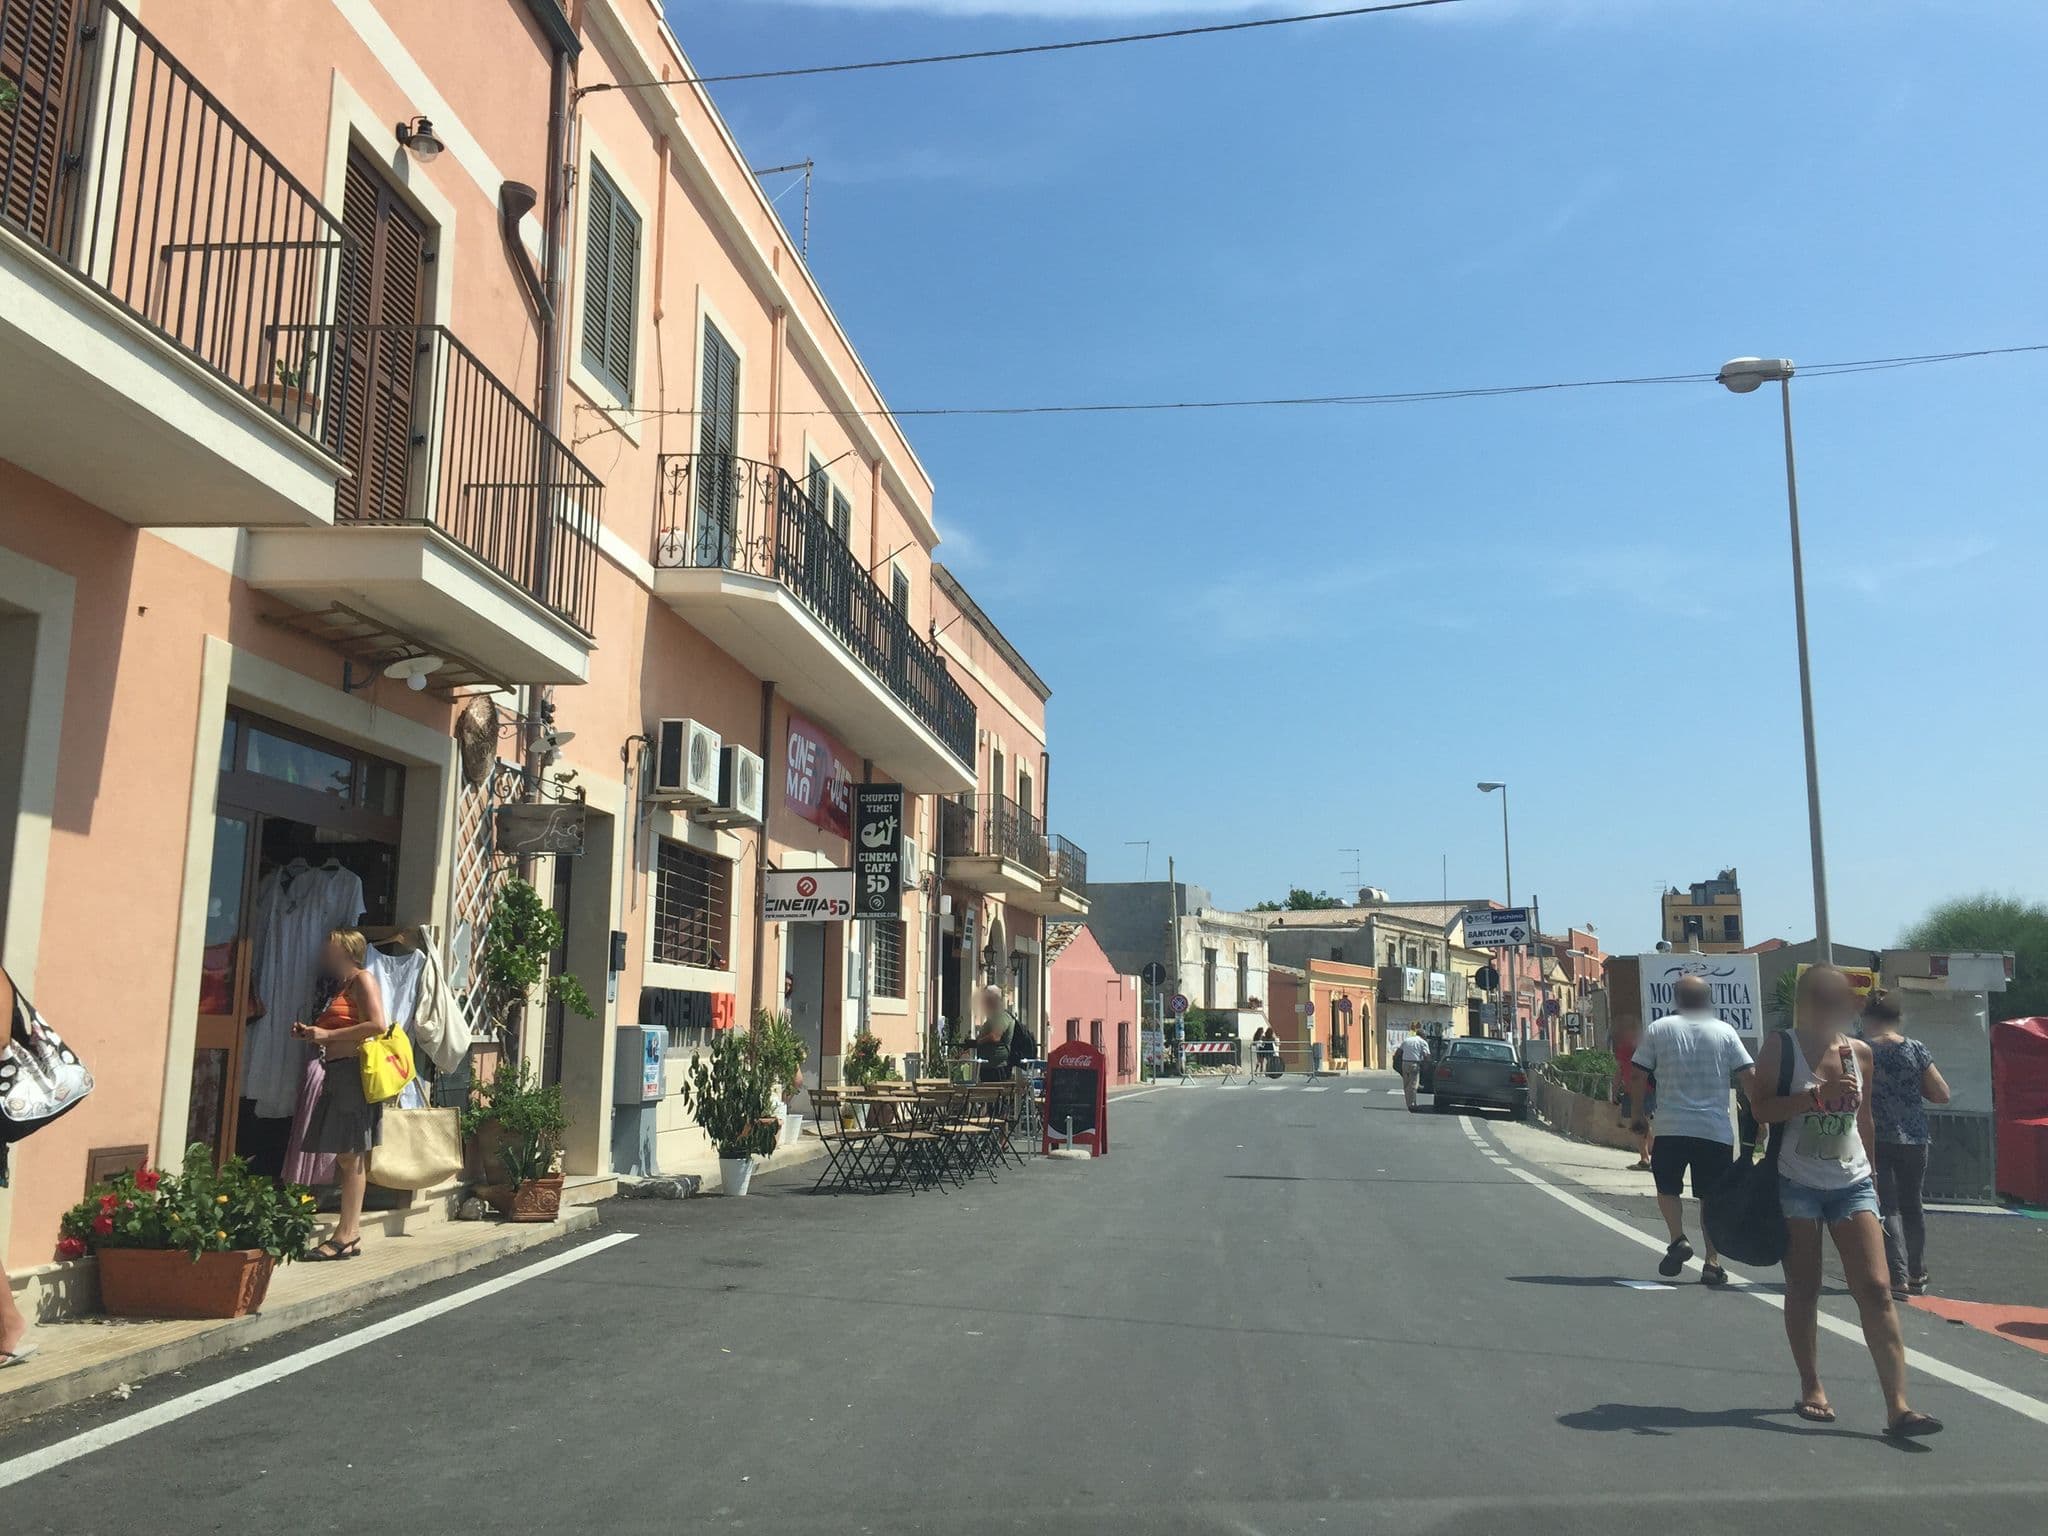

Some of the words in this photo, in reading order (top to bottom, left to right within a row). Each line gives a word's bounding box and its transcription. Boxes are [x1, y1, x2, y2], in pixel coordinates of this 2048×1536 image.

[860, 794, 899, 802] CHUPITO
[866, 804, 892, 812] TIME!
[859, 852, 898, 862] CINEMA
[865, 863, 891, 872] CAFE
[866, 874, 890, 893] 5D
[1493, 913, 1524, 921] Pachino
